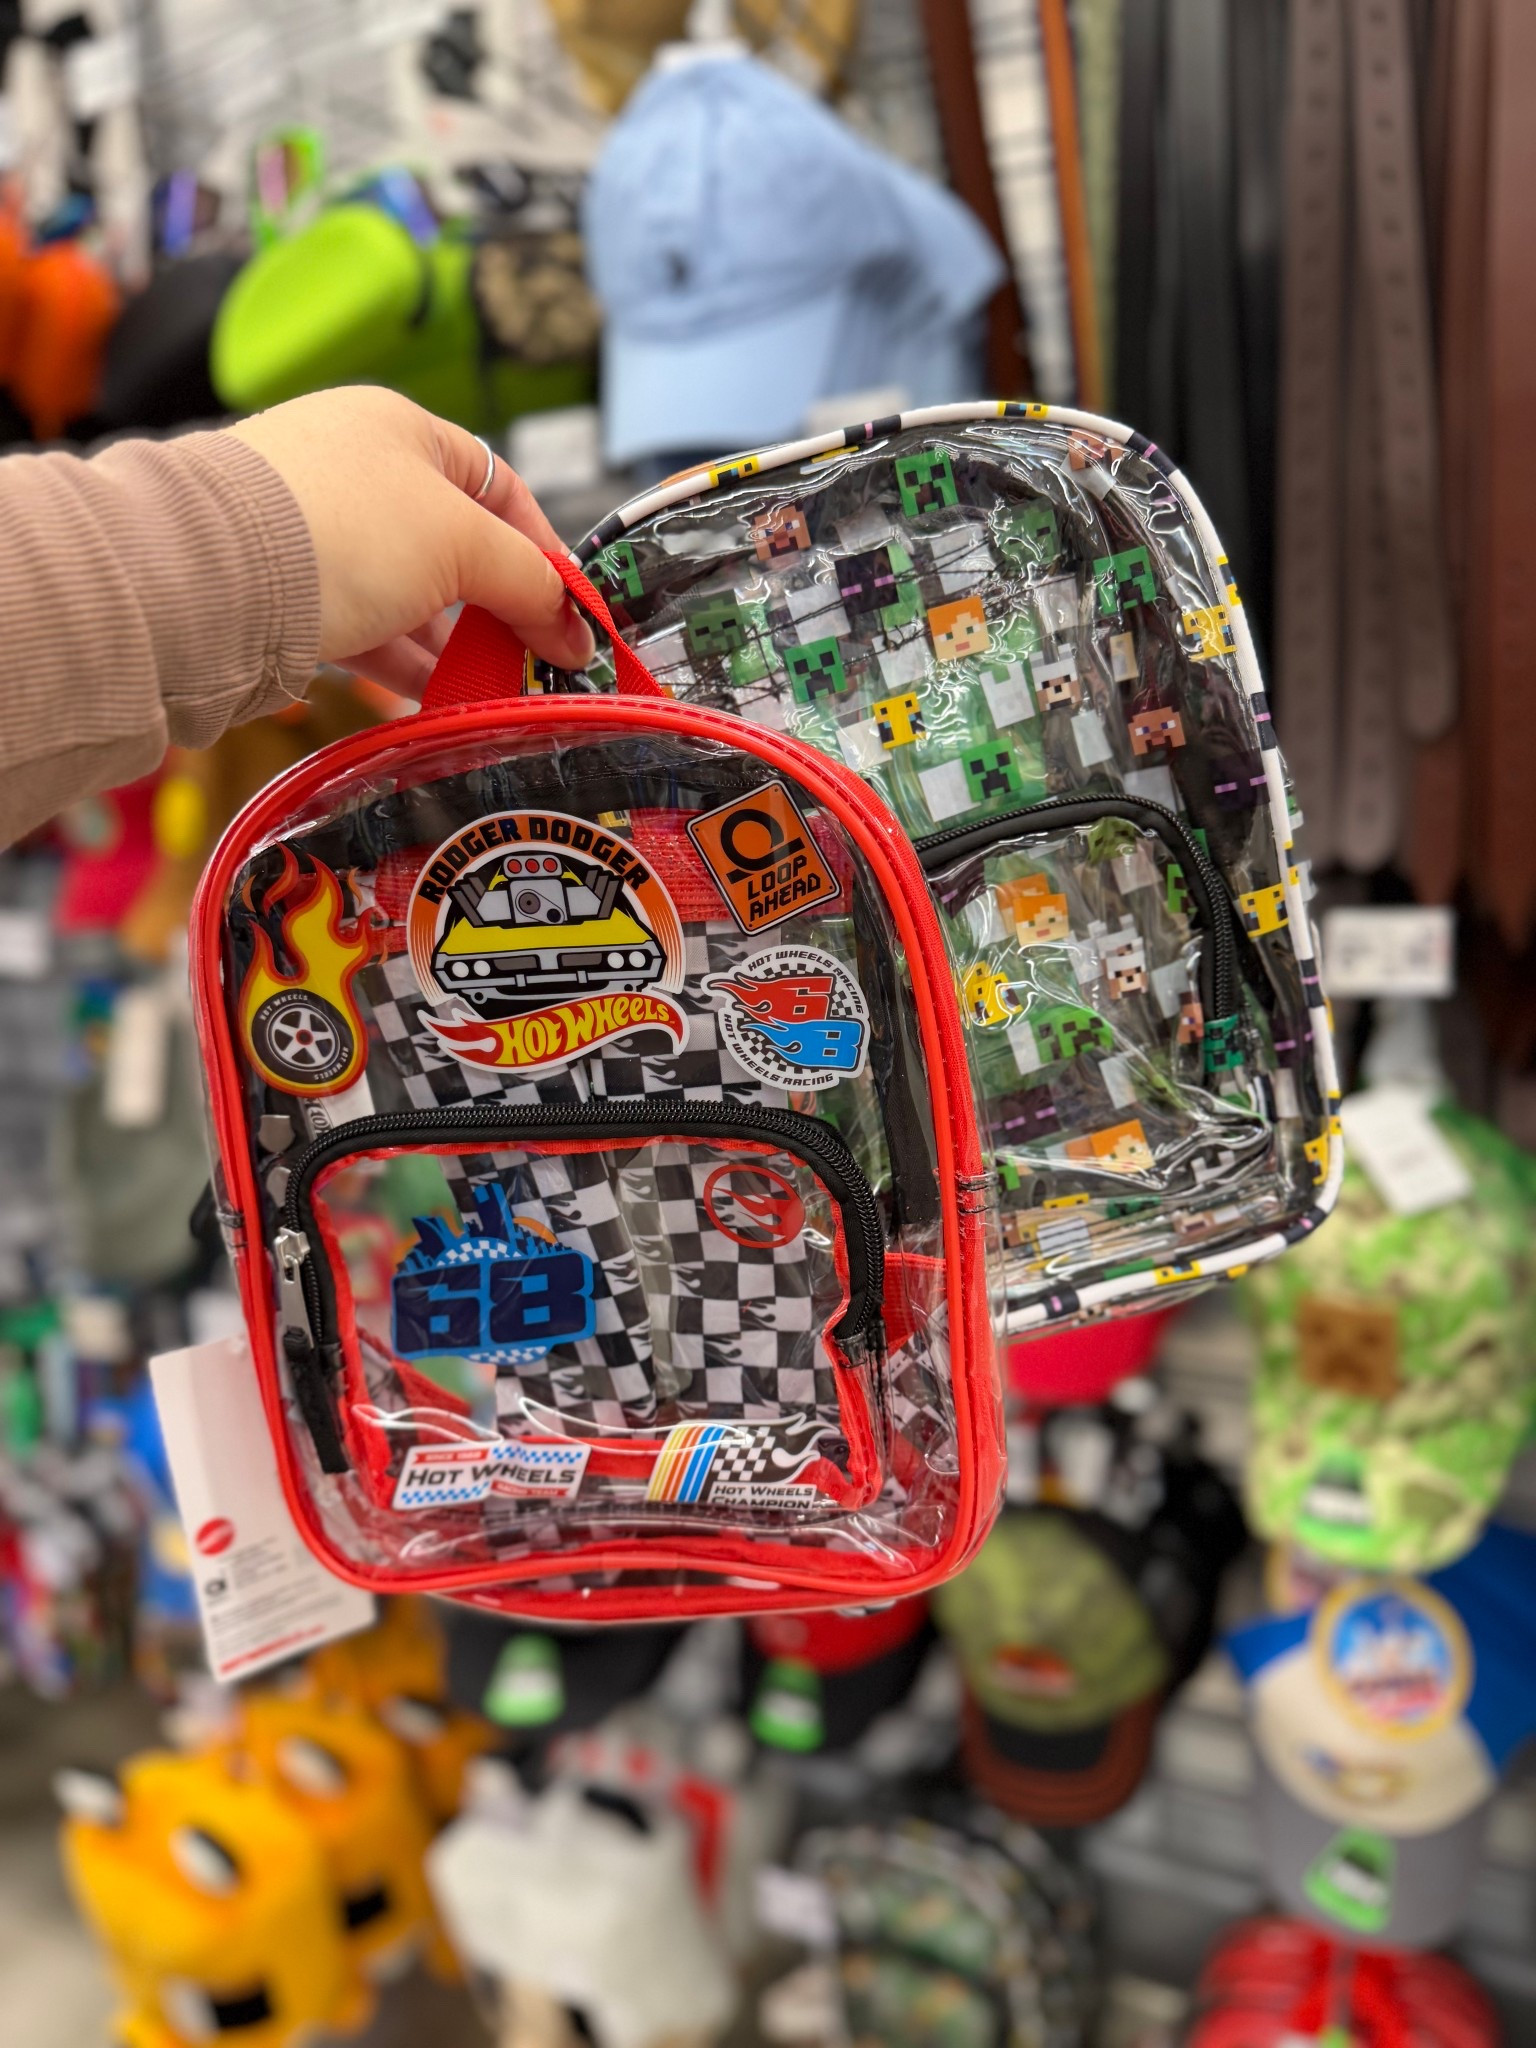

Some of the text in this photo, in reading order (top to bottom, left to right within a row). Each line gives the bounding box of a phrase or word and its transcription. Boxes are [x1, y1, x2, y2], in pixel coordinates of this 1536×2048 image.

[418, 817, 651, 905] RODGER DODGER
[747, 855, 821, 921] LOOP AHEAD
[260, 993, 308, 1021] HOT WHEELS
[748, 950, 864, 1014] HOT WHEELS RACING
[724, 1014, 834, 1086] HOT WHEELS RACING
[392, 1251, 594, 1357] 68
[405, 1463, 576, 1487] HOT WHEELS
[711, 1497, 810, 1509] CHAMPION
[714, 1485, 813, 1497] HOT WHEELS
